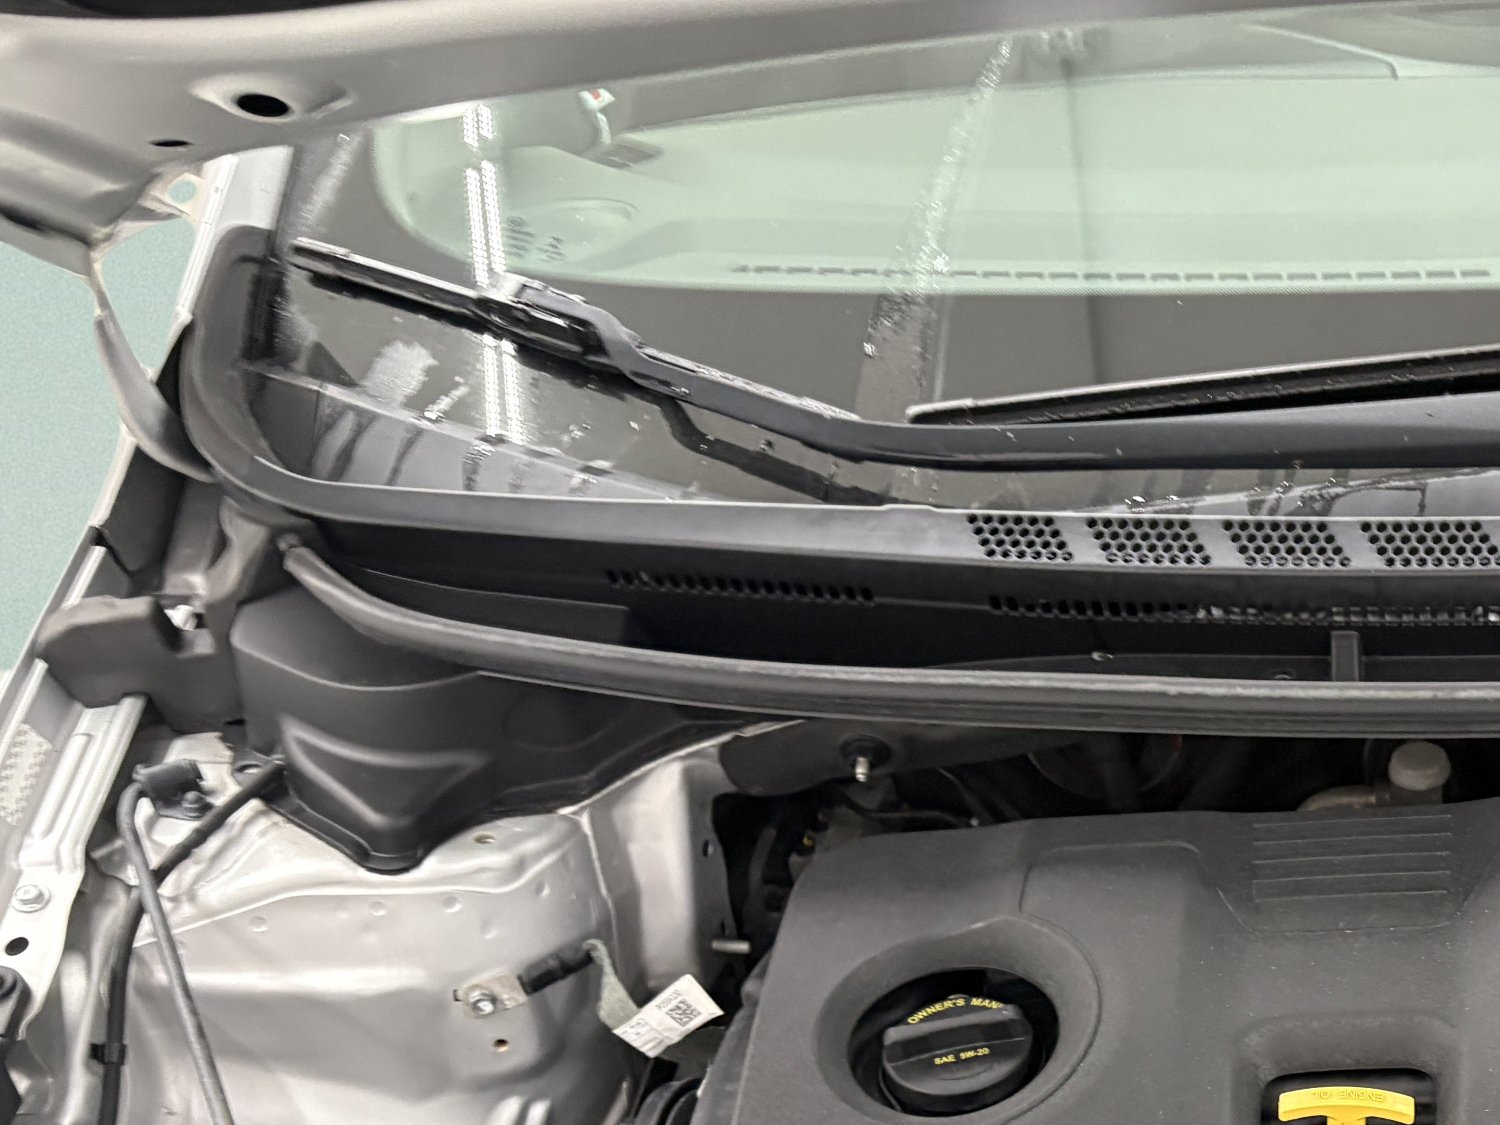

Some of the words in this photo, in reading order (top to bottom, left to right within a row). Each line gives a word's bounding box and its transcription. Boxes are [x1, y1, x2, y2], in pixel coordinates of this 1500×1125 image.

[907, 998, 966, 1024] OWNER'S
[933, 1054, 956, 1065] SAE
[960, 1047, 990, 1060] 5W-20
